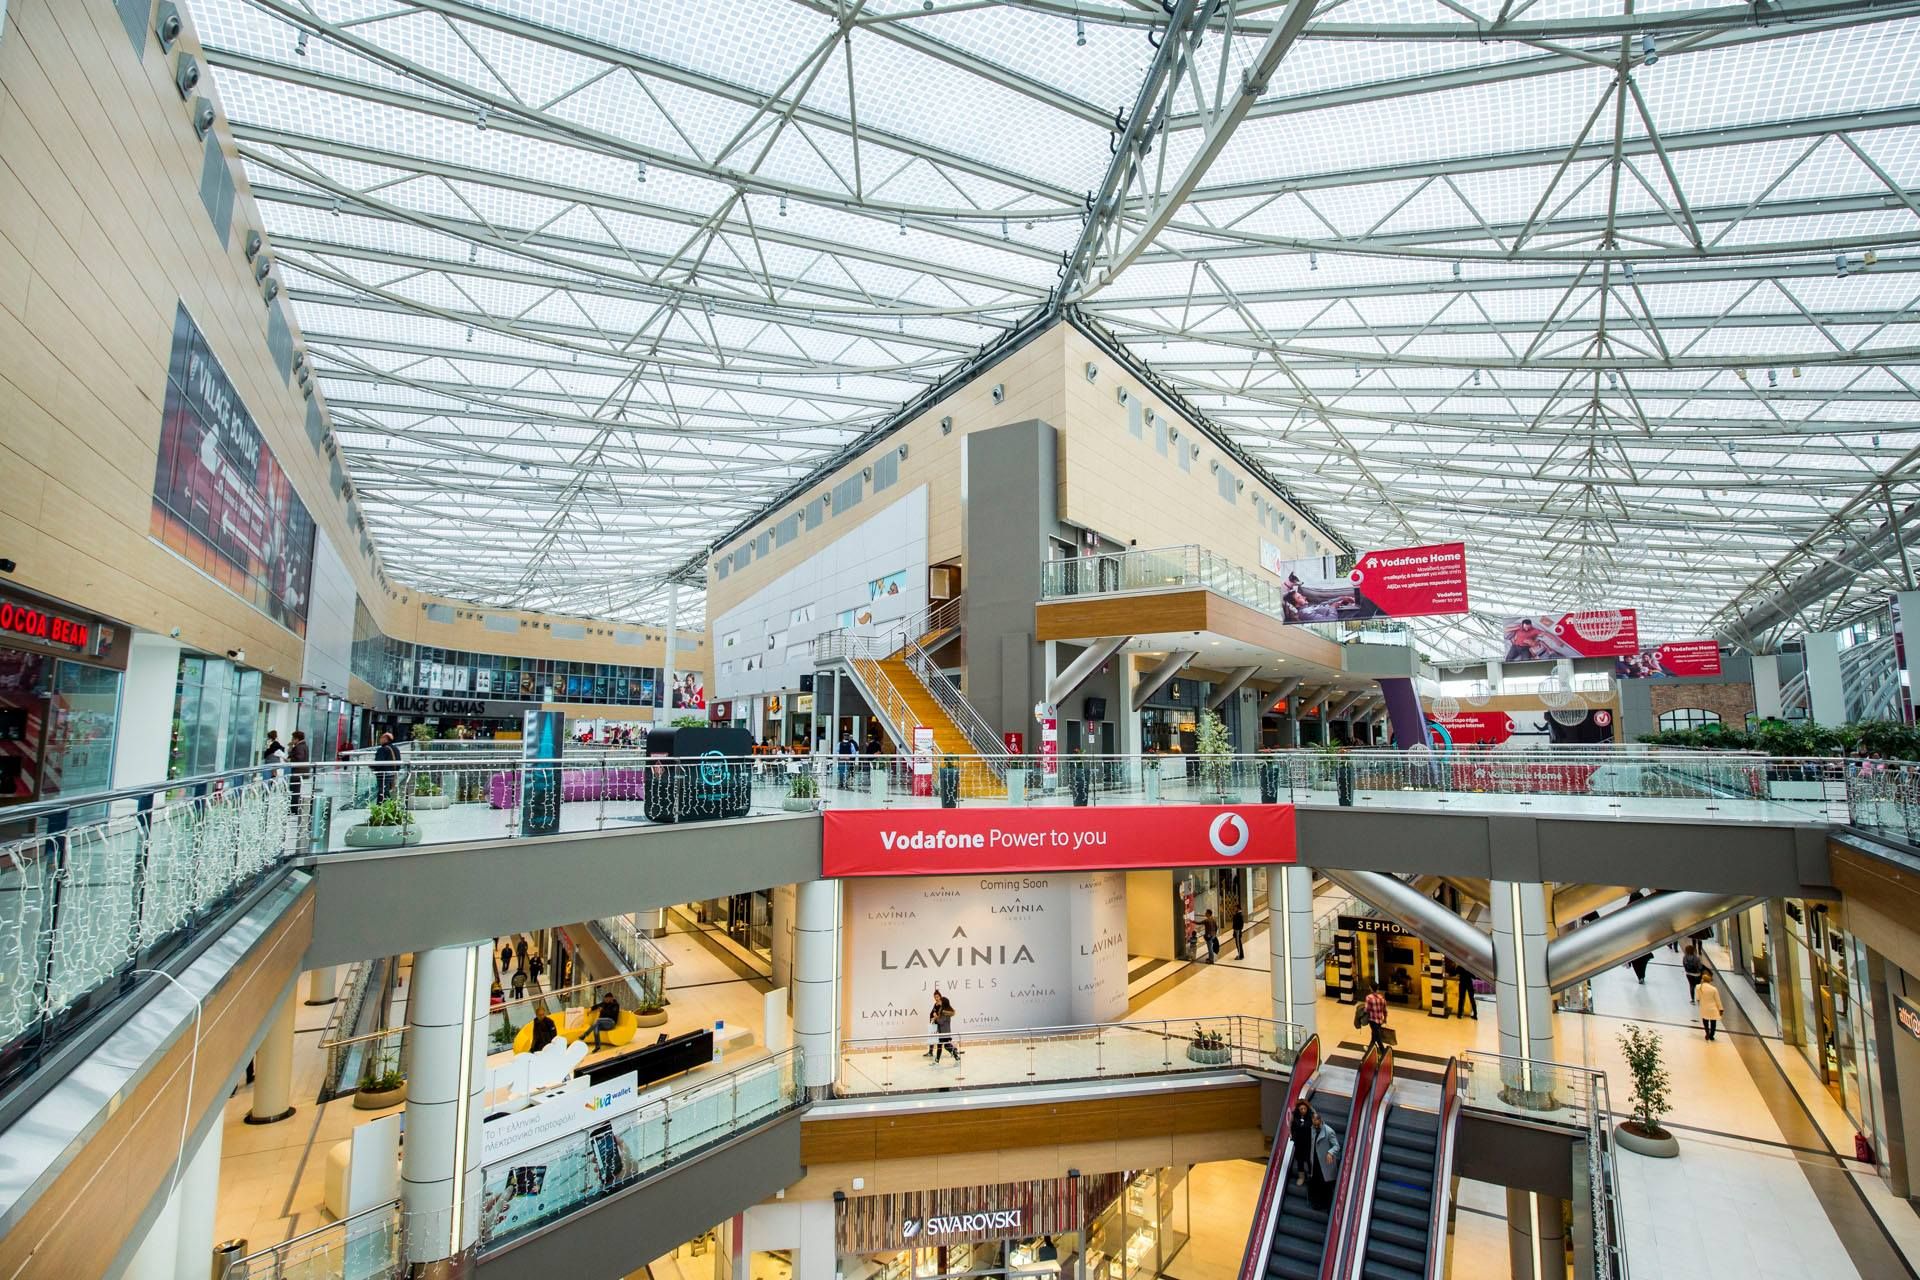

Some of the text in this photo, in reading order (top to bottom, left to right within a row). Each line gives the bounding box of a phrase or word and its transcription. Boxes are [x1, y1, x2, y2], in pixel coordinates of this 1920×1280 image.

[199, 362, 230, 429] VILLAGE
[1380, 553, 1461, 568] Vodafone Home
[52, 617, 88, 648] BEAN
[394, 698, 486, 714] VILLAGE CINEMAS
[880, 829, 1107, 850] Vodafone Power to you
[980, 878, 1049, 892] Coming Soon
[924, 890, 961, 898] LAVINIA
[868, 911, 917, 920] LAVINIA
[991, 904, 1045, 914] LAVINIA
[881, 943, 1035, 970] LAVINIA
[921, 977, 998, 992] JEWELS
[1010, 987, 1056, 998] LAVINIA
[861, 1008, 919, 1019] LAVINIA
[612, 1086, 631, 1100] wallet
[927, 1210, 1020, 1235] SWAROVSKI
